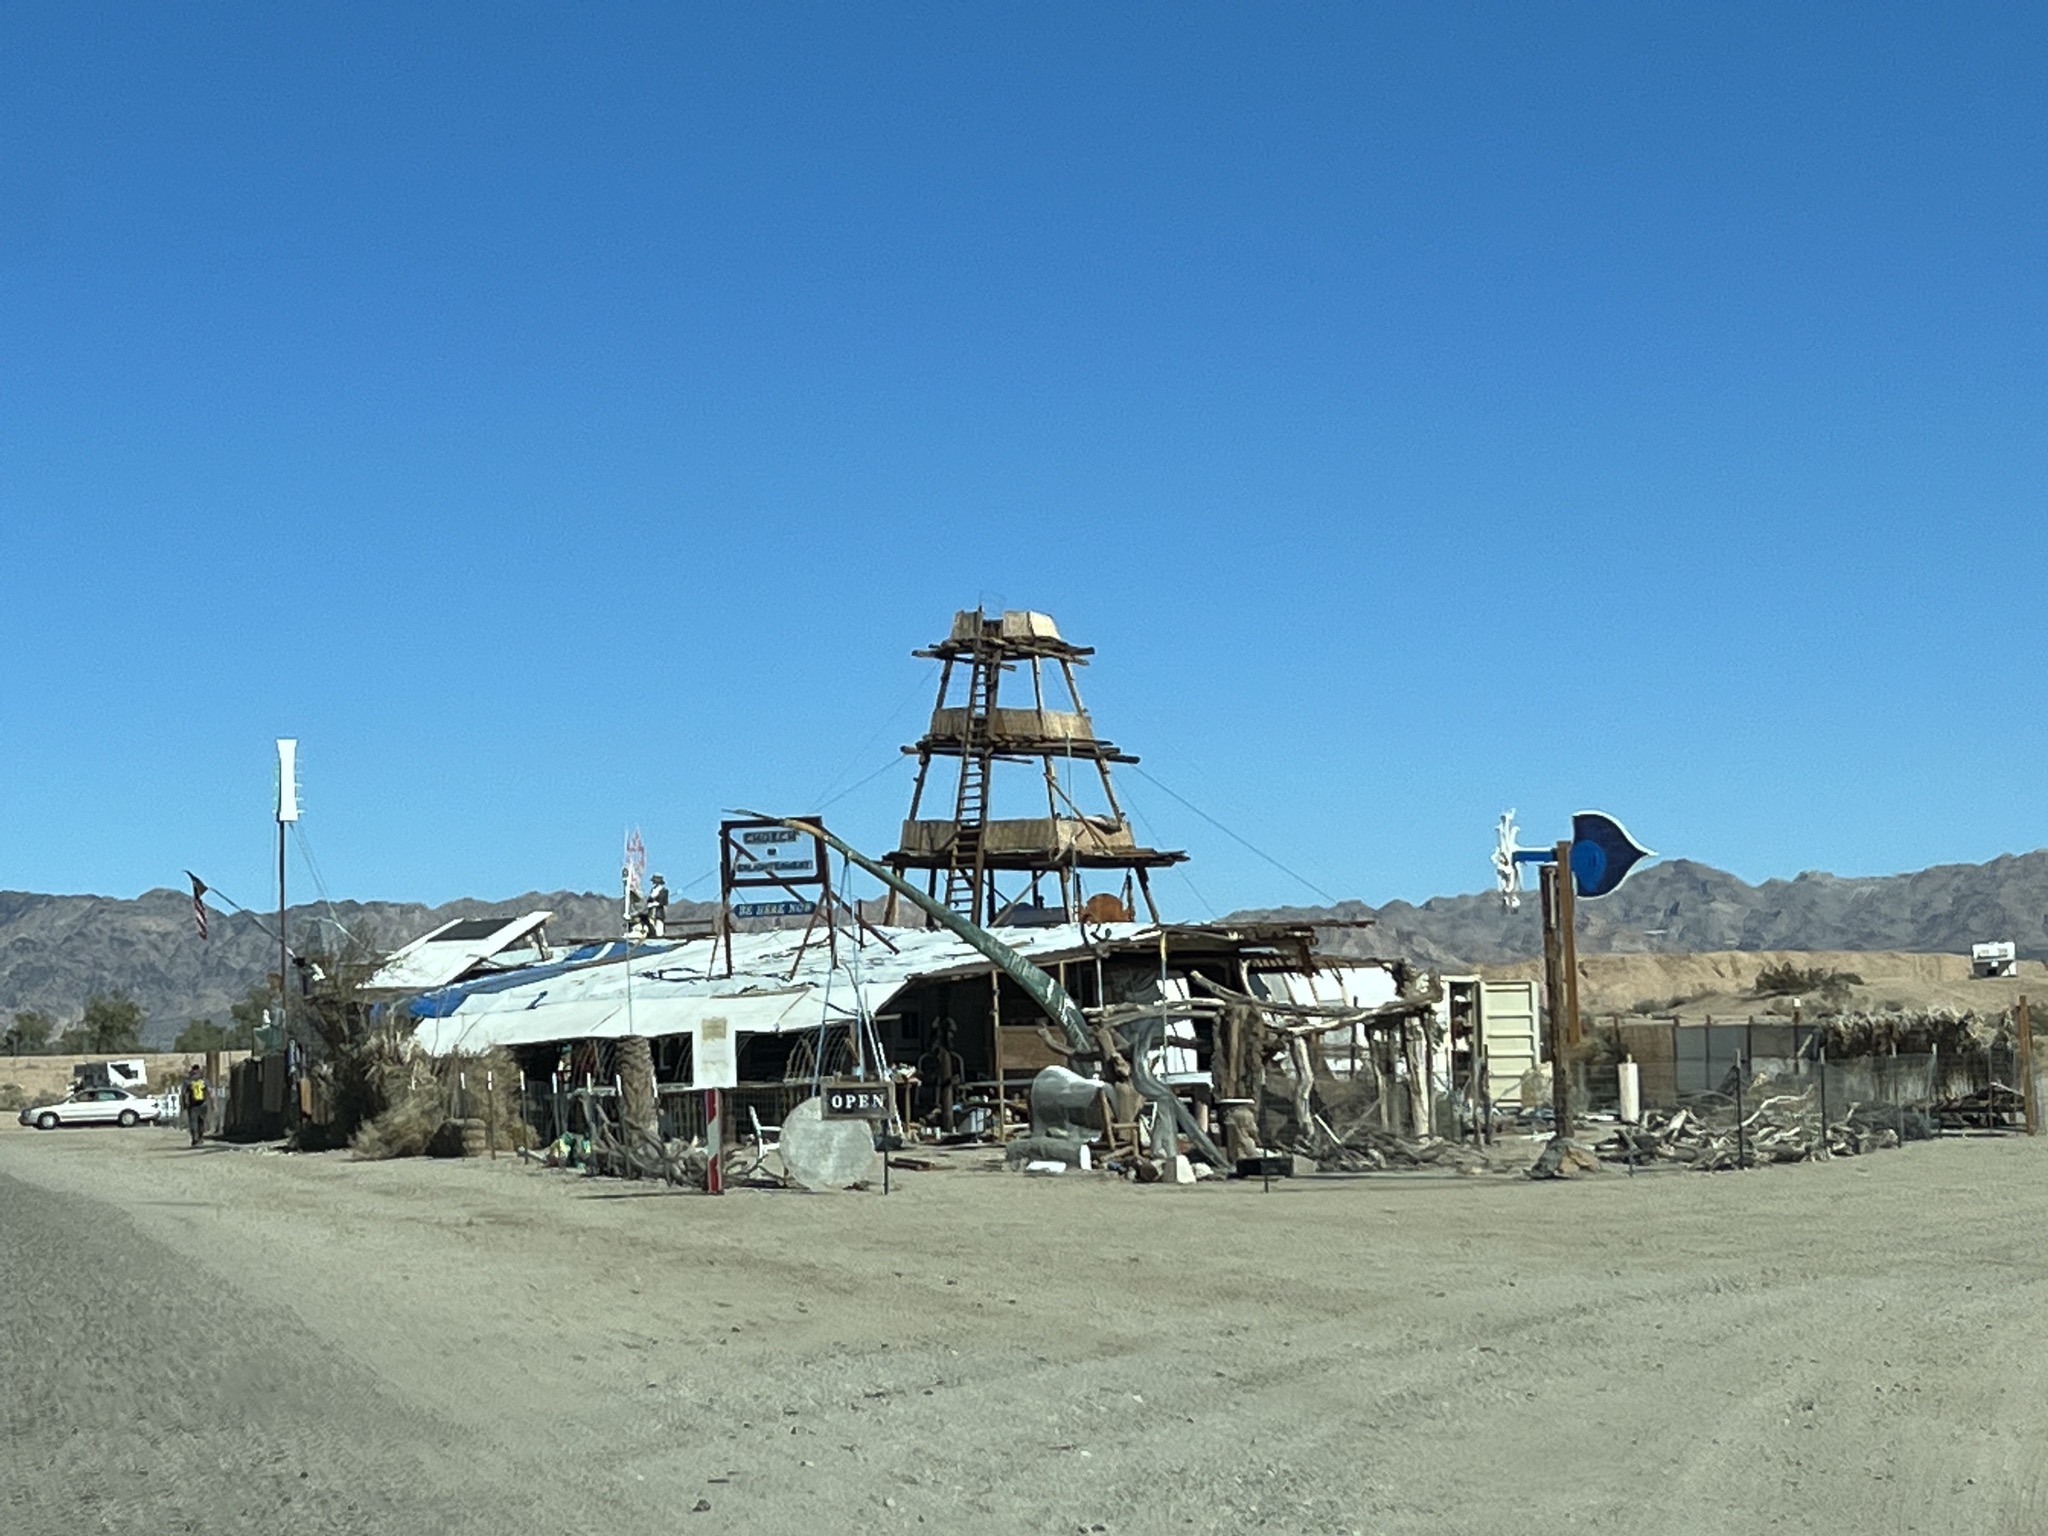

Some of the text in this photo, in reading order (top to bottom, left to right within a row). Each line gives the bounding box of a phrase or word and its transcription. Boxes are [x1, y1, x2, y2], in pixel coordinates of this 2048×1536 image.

[738, 902, 812, 915] BE HERE NOW
[831, 1094, 885, 1109] OPEN
